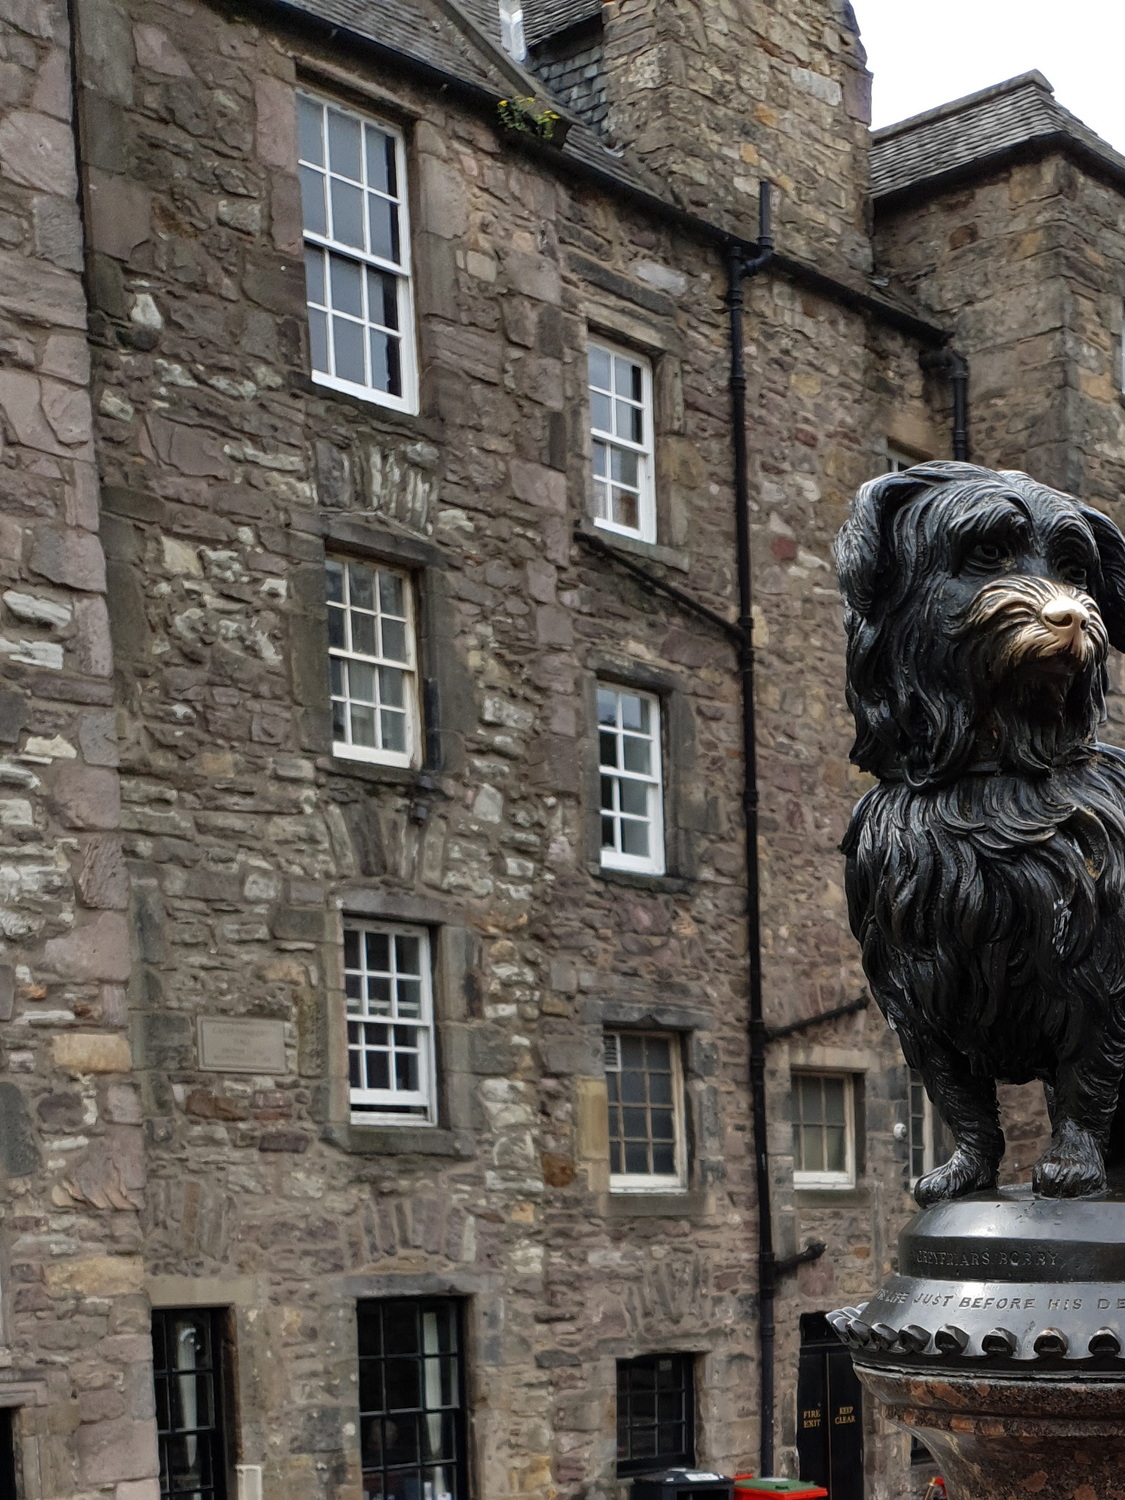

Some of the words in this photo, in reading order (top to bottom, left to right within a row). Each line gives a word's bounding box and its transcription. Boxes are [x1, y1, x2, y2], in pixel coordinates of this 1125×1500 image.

[916, 1250, 991, 1267] GREYFRIARS
[999, 1251, 1059, 1267] BOBBY
[913, 1292, 954, 1308] JUST
[958, 1297, 1036, 1310] BEFORE
[1047, 1298, 1083, 1311] HIS
[803, 1410, 821, 1419] FIRE
[839, 1406, 854, 1415] KEEP
[803, 1420, 821, 1429] EXIT
[834, 1415, 856, 1425] CLEAR
